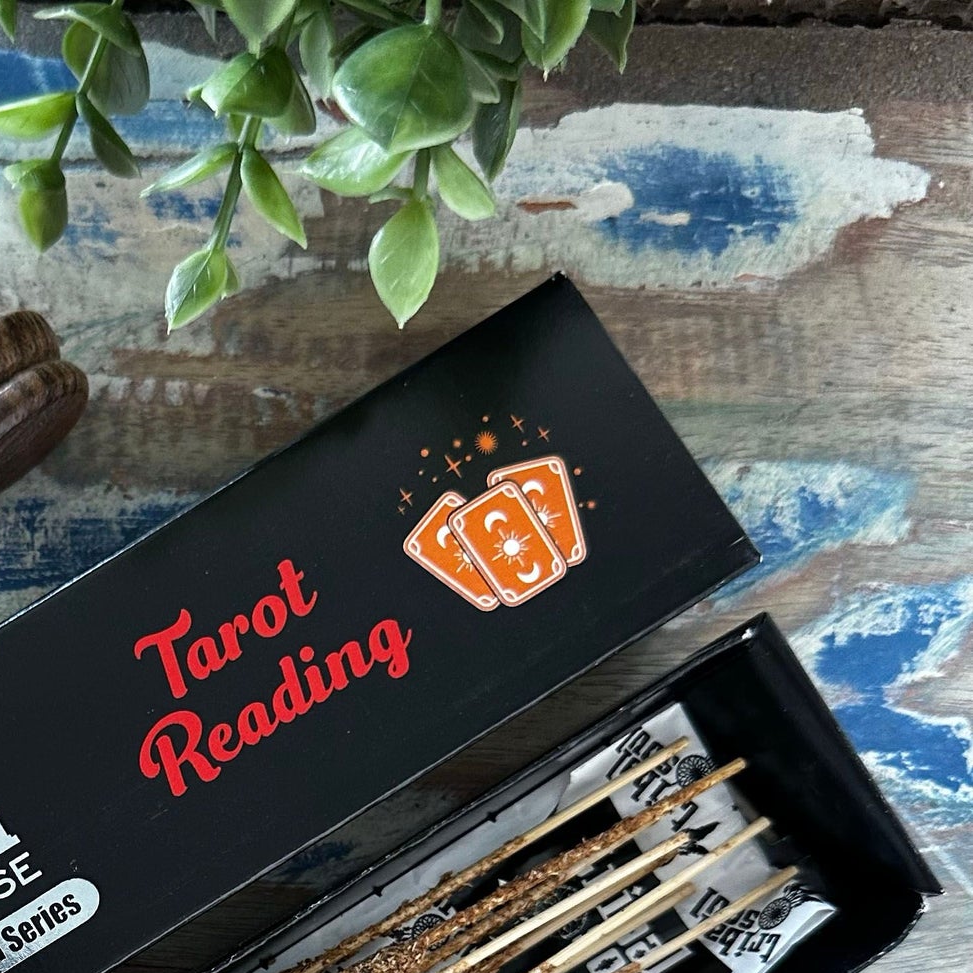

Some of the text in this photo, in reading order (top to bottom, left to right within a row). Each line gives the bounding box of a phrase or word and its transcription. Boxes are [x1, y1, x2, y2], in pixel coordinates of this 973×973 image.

[134, 559, 318, 699] Tarot
[139, 617, 413, 797] Reading
[1, 893, 82, 952] Series
